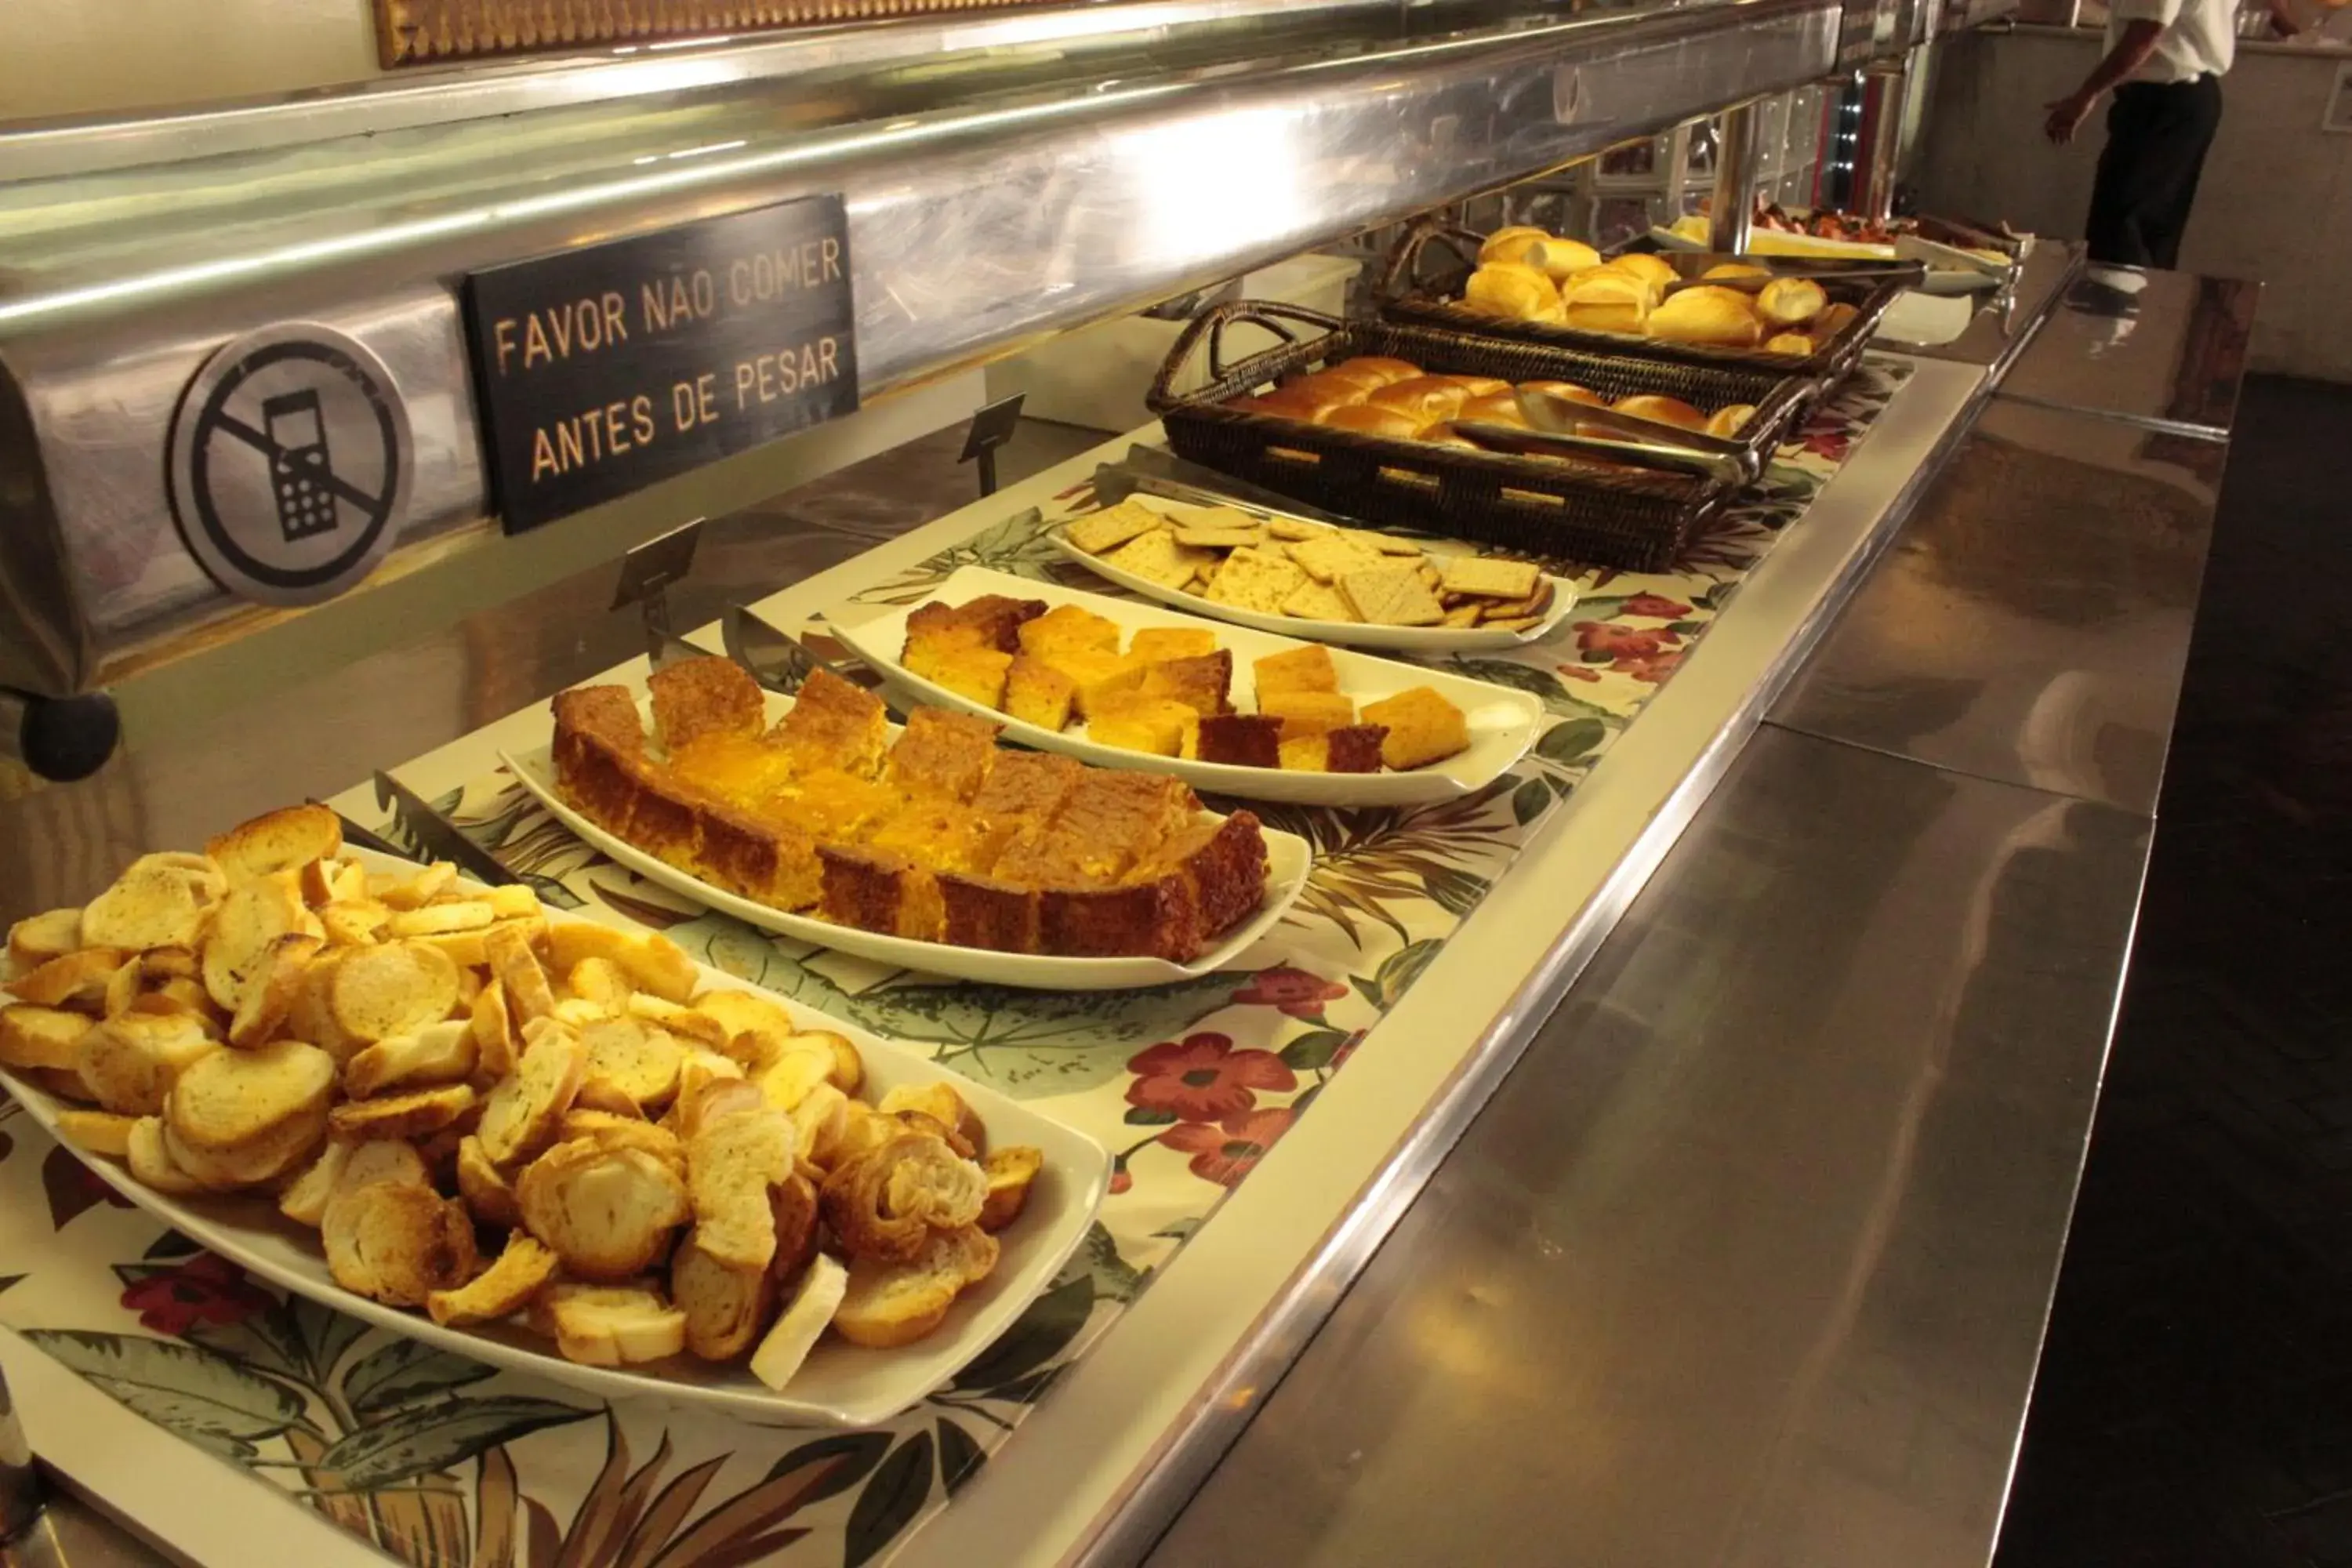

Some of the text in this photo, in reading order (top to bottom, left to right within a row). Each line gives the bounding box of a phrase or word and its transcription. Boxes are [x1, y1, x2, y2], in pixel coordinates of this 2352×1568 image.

[494, 292, 628, 376] FAVOR
[730, 238, 841, 307] COMER
[532, 337, 839, 483] ANTES DE PESAR
